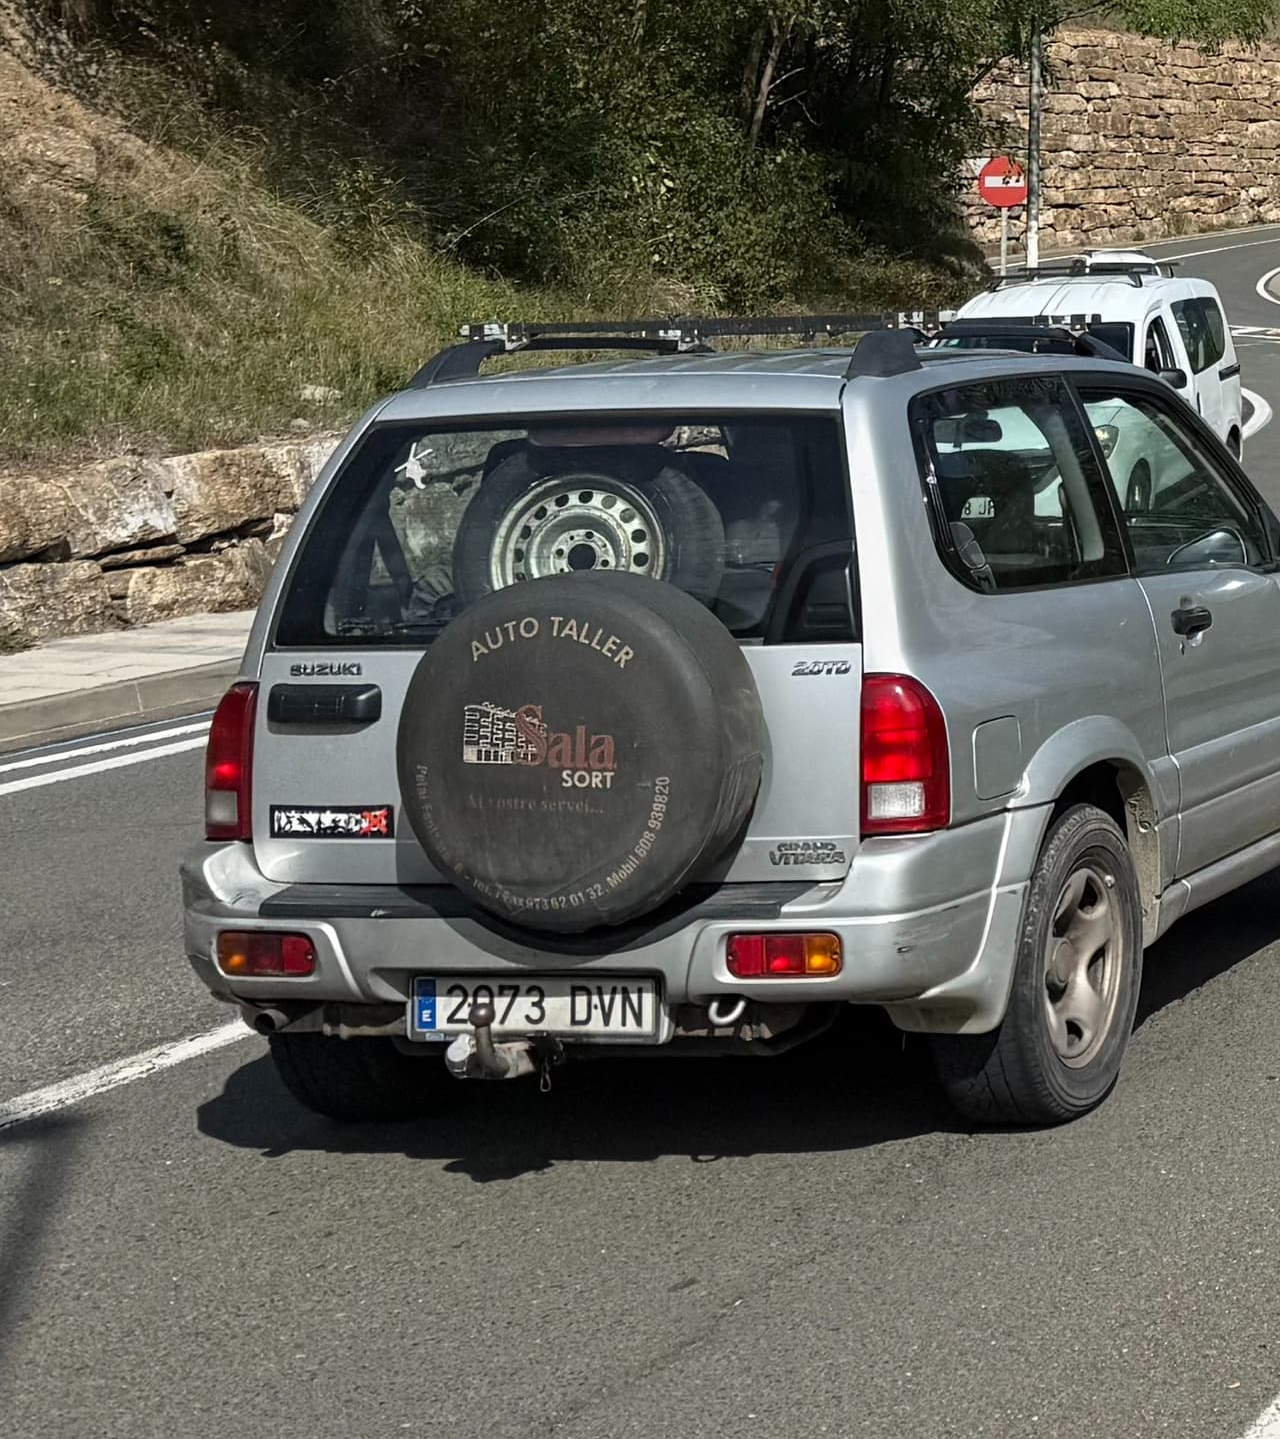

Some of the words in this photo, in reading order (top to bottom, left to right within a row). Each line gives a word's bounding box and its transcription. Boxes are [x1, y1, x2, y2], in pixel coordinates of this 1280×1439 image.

[472, 617, 539, 662] AUTO
[550, 616, 635, 668] TALLER
[290, 663, 363, 677] SUZUKI
[514, 704, 616, 769] Sala
[562, 770, 615, 788] SORT
[570, 891, 585, 906] 01
[606, 855, 640, 888] Mobil
[635, 831, 656, 858] 608
[648, 776, 670, 830] 939820
[769, 851, 846, 866] VITARA
[422, 1010, 432, 1023] E
[570, 986, 643, 1027] DVN
